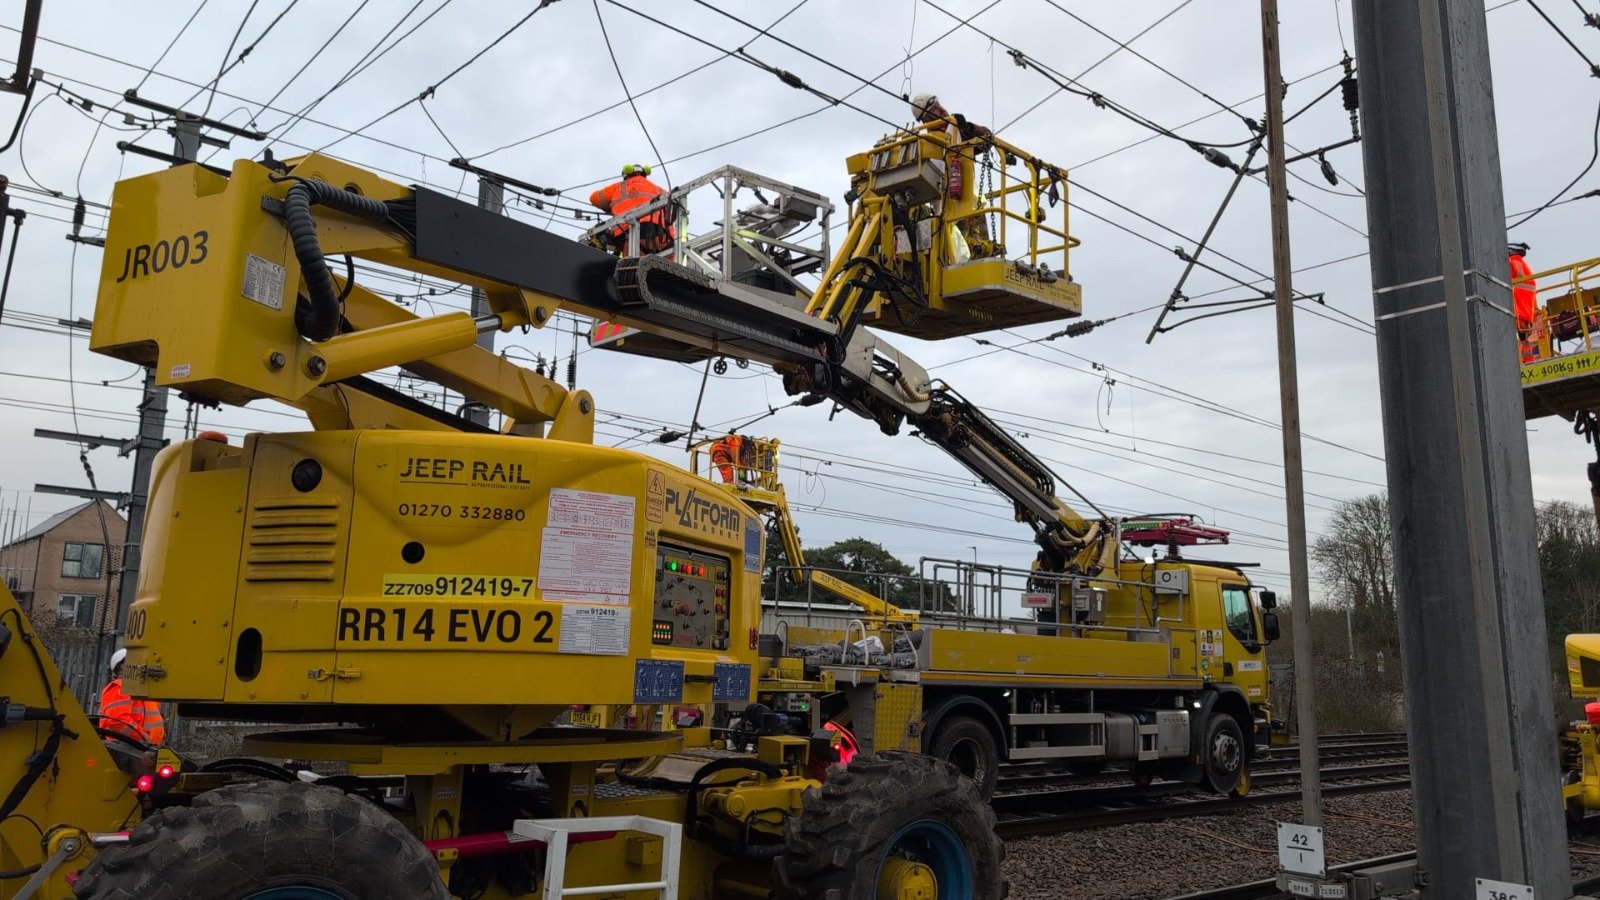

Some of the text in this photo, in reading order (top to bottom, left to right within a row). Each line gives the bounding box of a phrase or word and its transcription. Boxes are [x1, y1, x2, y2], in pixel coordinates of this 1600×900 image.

[117, 230, 209, 283] JR003
[1520, 369, 1539, 379] AX.
[400, 458, 531, 484] JEEP RAIL
[398, 503, 526, 522] 01270 332880
[665, 487, 740, 533] PLATFORM
[693, 522, 739, 541] BASKET
[338, 608, 435, 642] RR14
[448, 609, 522, 643] EVO
[533, 611, 554, 644] 2
[1291, 834, 1309, 846] 42
